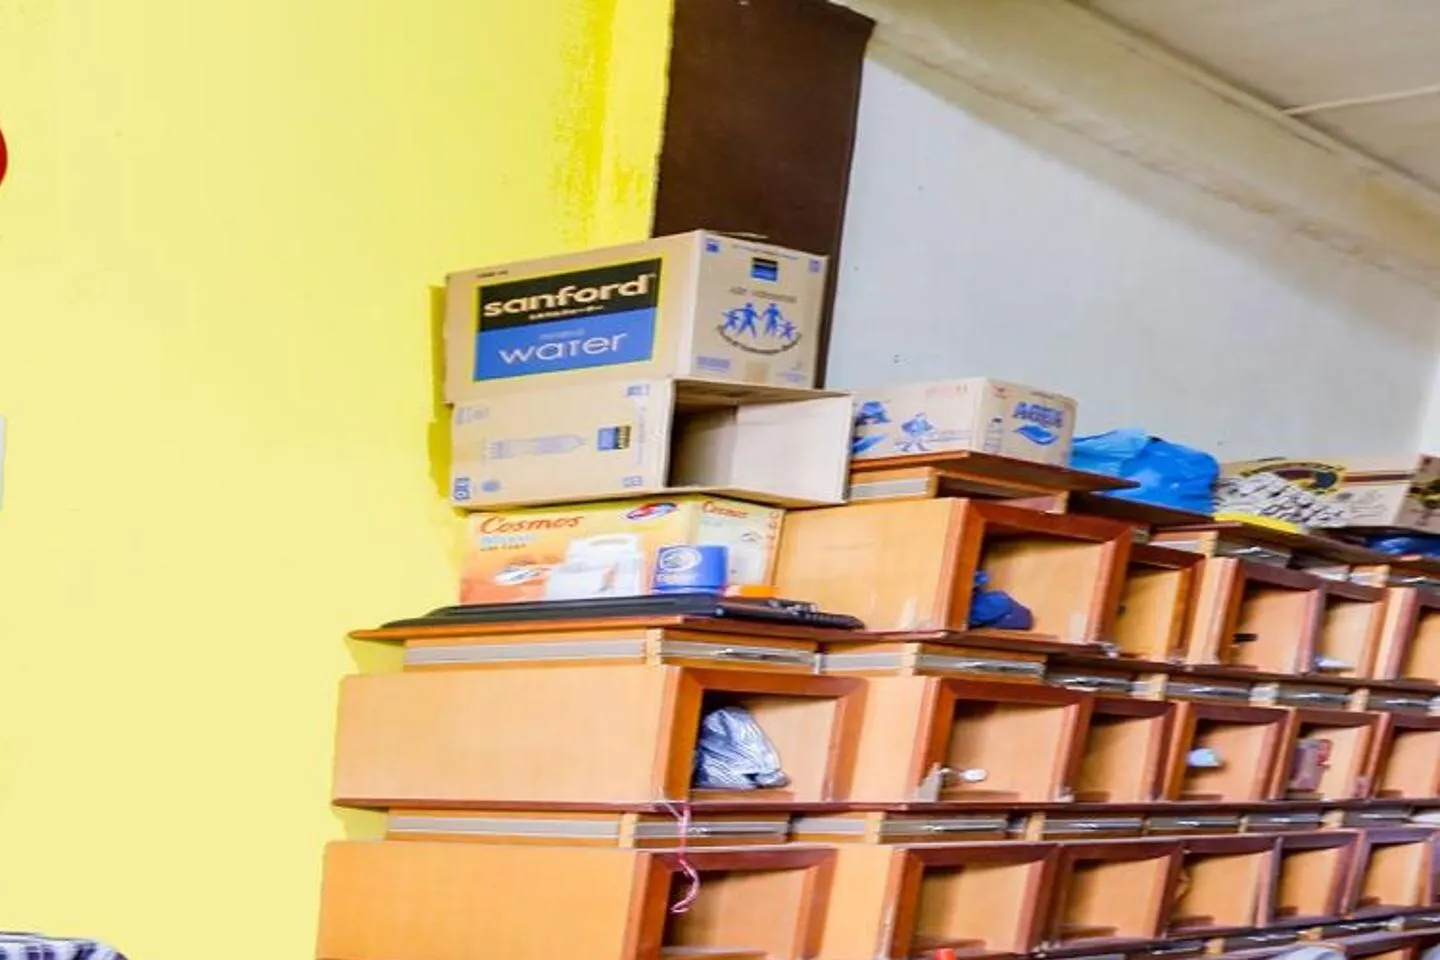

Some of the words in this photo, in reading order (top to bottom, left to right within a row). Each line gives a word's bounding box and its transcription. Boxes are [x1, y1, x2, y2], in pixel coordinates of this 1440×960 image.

[483, 273, 649, 318] sanford
[499, 333, 627, 365] water
[480, 515, 584, 534] Cosmos
